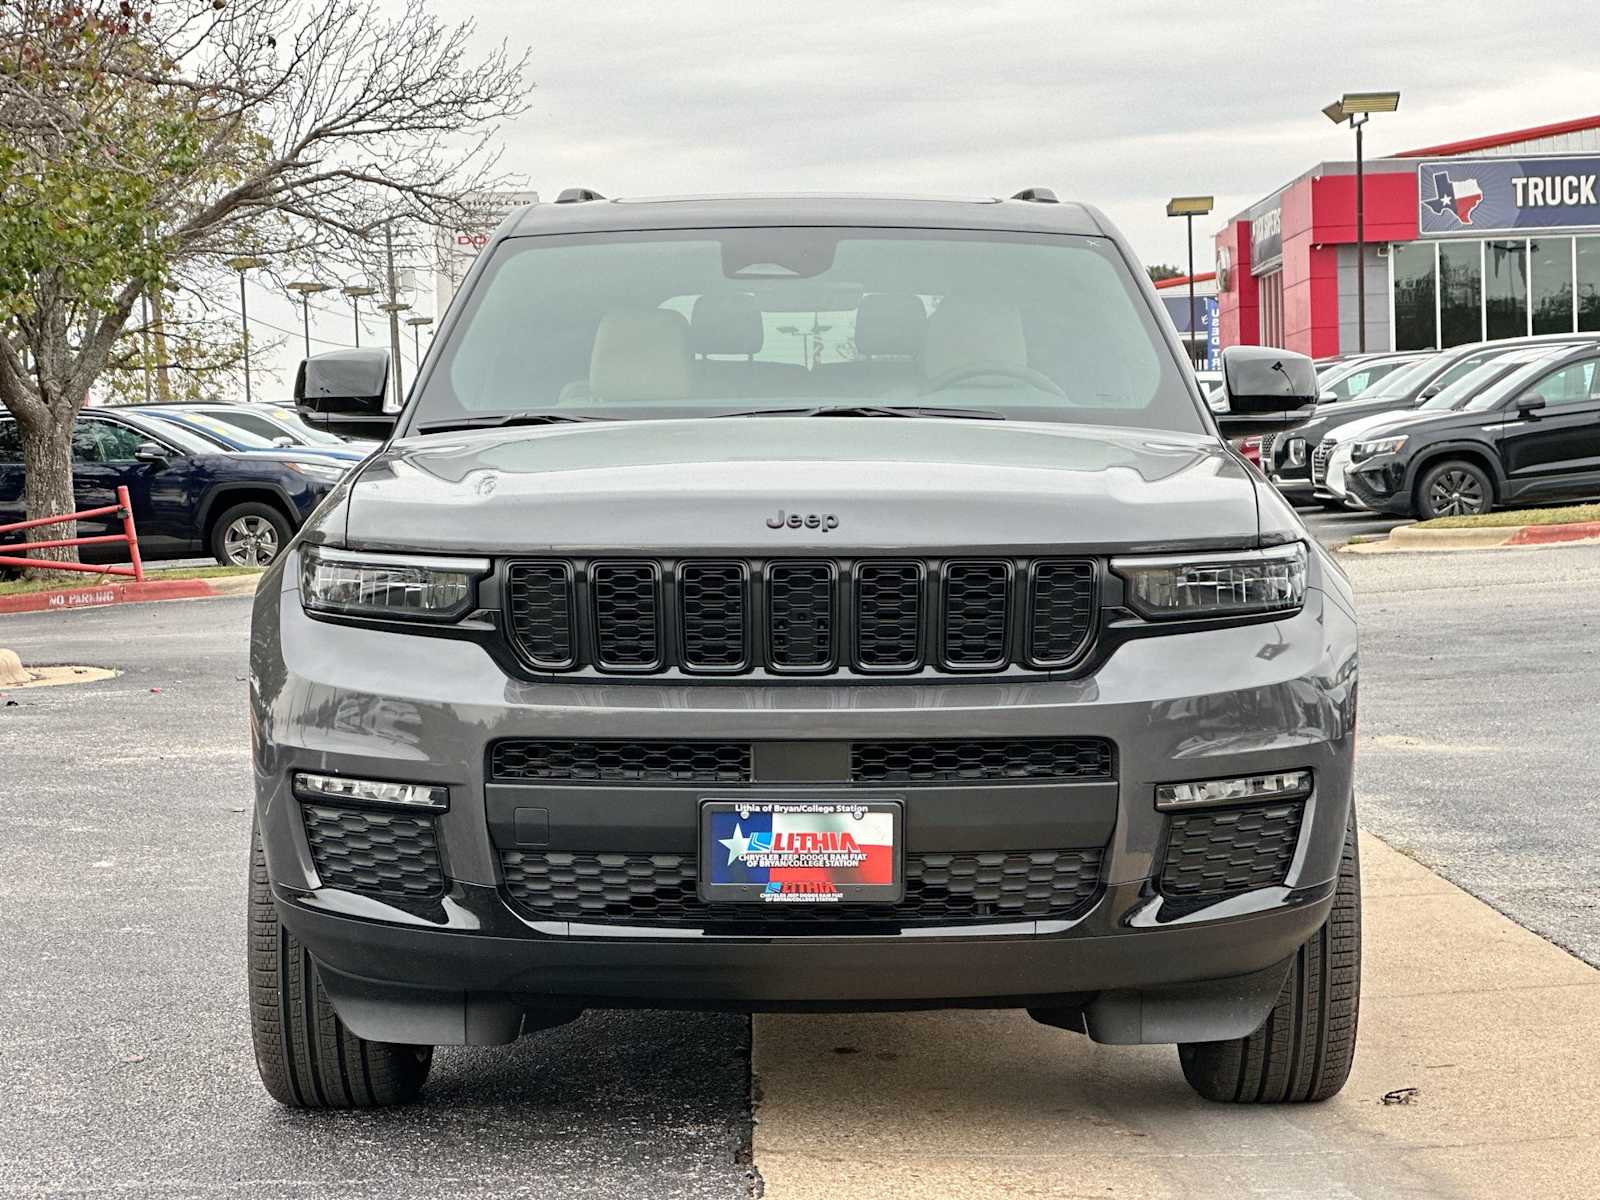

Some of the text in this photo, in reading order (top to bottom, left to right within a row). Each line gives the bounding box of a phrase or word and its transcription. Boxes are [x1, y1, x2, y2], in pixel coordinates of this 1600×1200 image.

[1511, 175, 1597, 207] TRUCK
[766, 509, 839, 533] Jeep
[49, 591, 114, 606] NO PARKING
[735, 804, 868, 814] Lithia of Bryan/College Station
[773, 832, 860, 852] LITHIA
